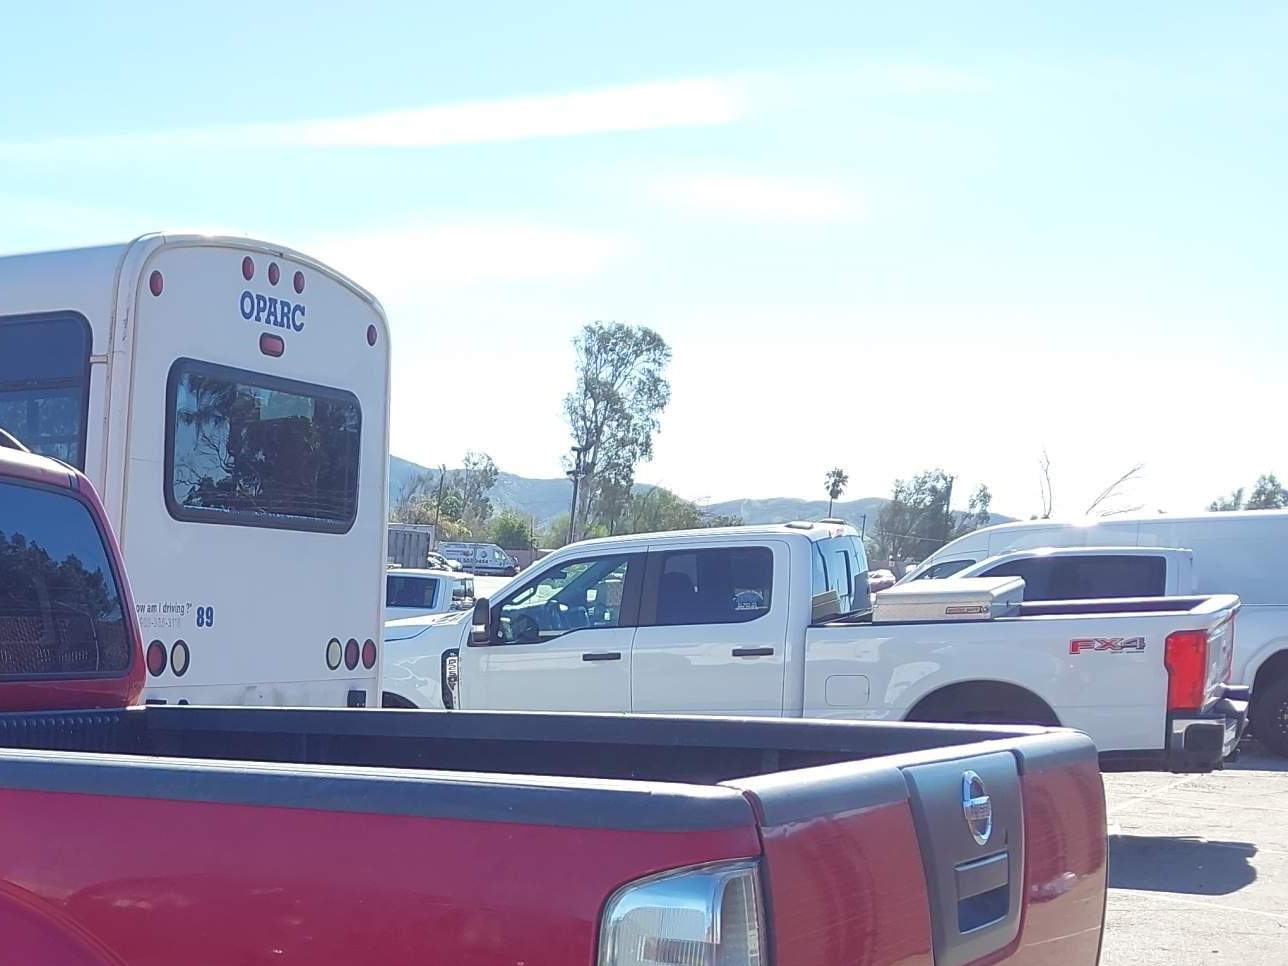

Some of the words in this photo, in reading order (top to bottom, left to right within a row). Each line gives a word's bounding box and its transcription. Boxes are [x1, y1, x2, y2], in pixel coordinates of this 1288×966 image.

[240, 290, 306, 332] OPARC
[163, 601, 185, 616] driving
[196, 606, 214, 628] 89
[1069, 637, 1145, 654] FX4
